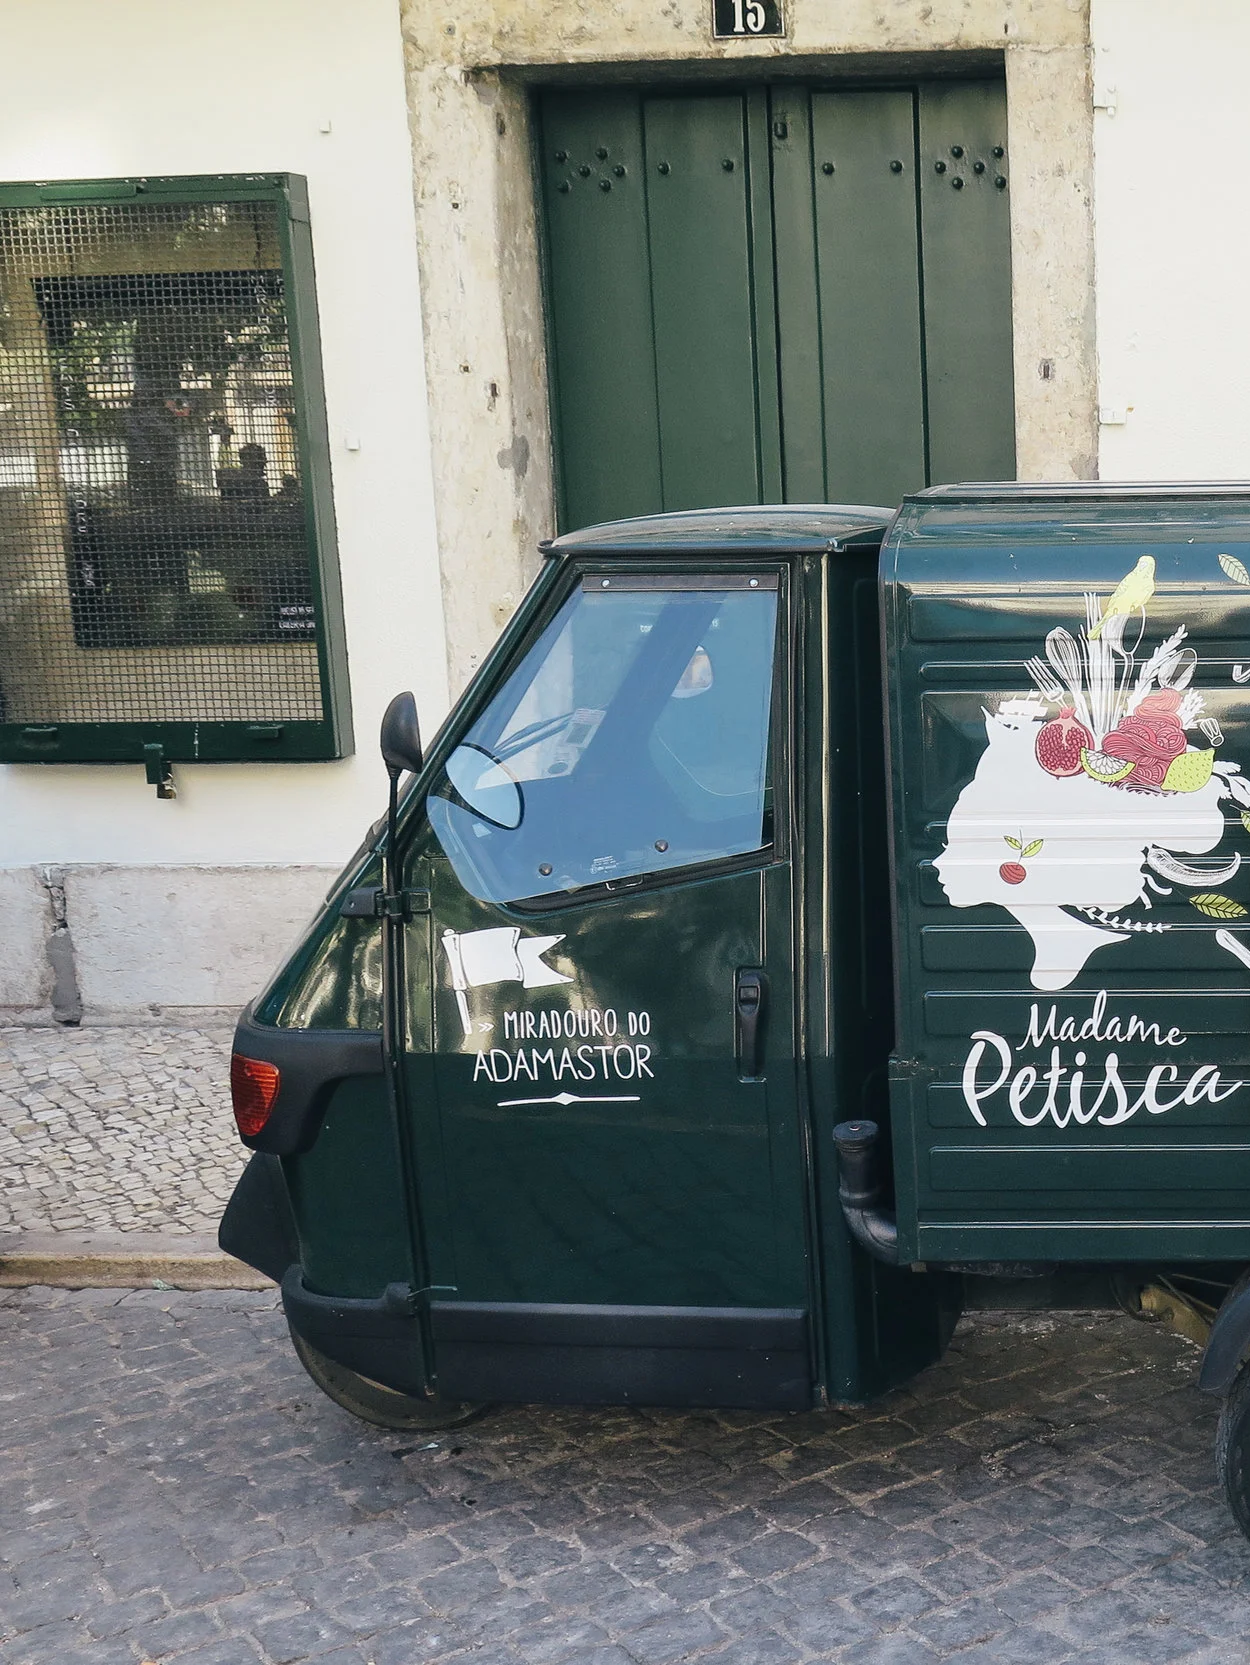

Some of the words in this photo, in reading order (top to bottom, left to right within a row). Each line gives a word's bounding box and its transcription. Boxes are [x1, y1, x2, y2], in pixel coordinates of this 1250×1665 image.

[732, 0, 766, 32] 15
[504, 1009, 617, 1038] MIRADOURO
[629, 1012, 650, 1035] DO
[1015, 989, 1187, 1051] Madame
[473, 1044, 654, 1083] ADAMASTOR
[962, 1030, 1243, 1129] Petisca
